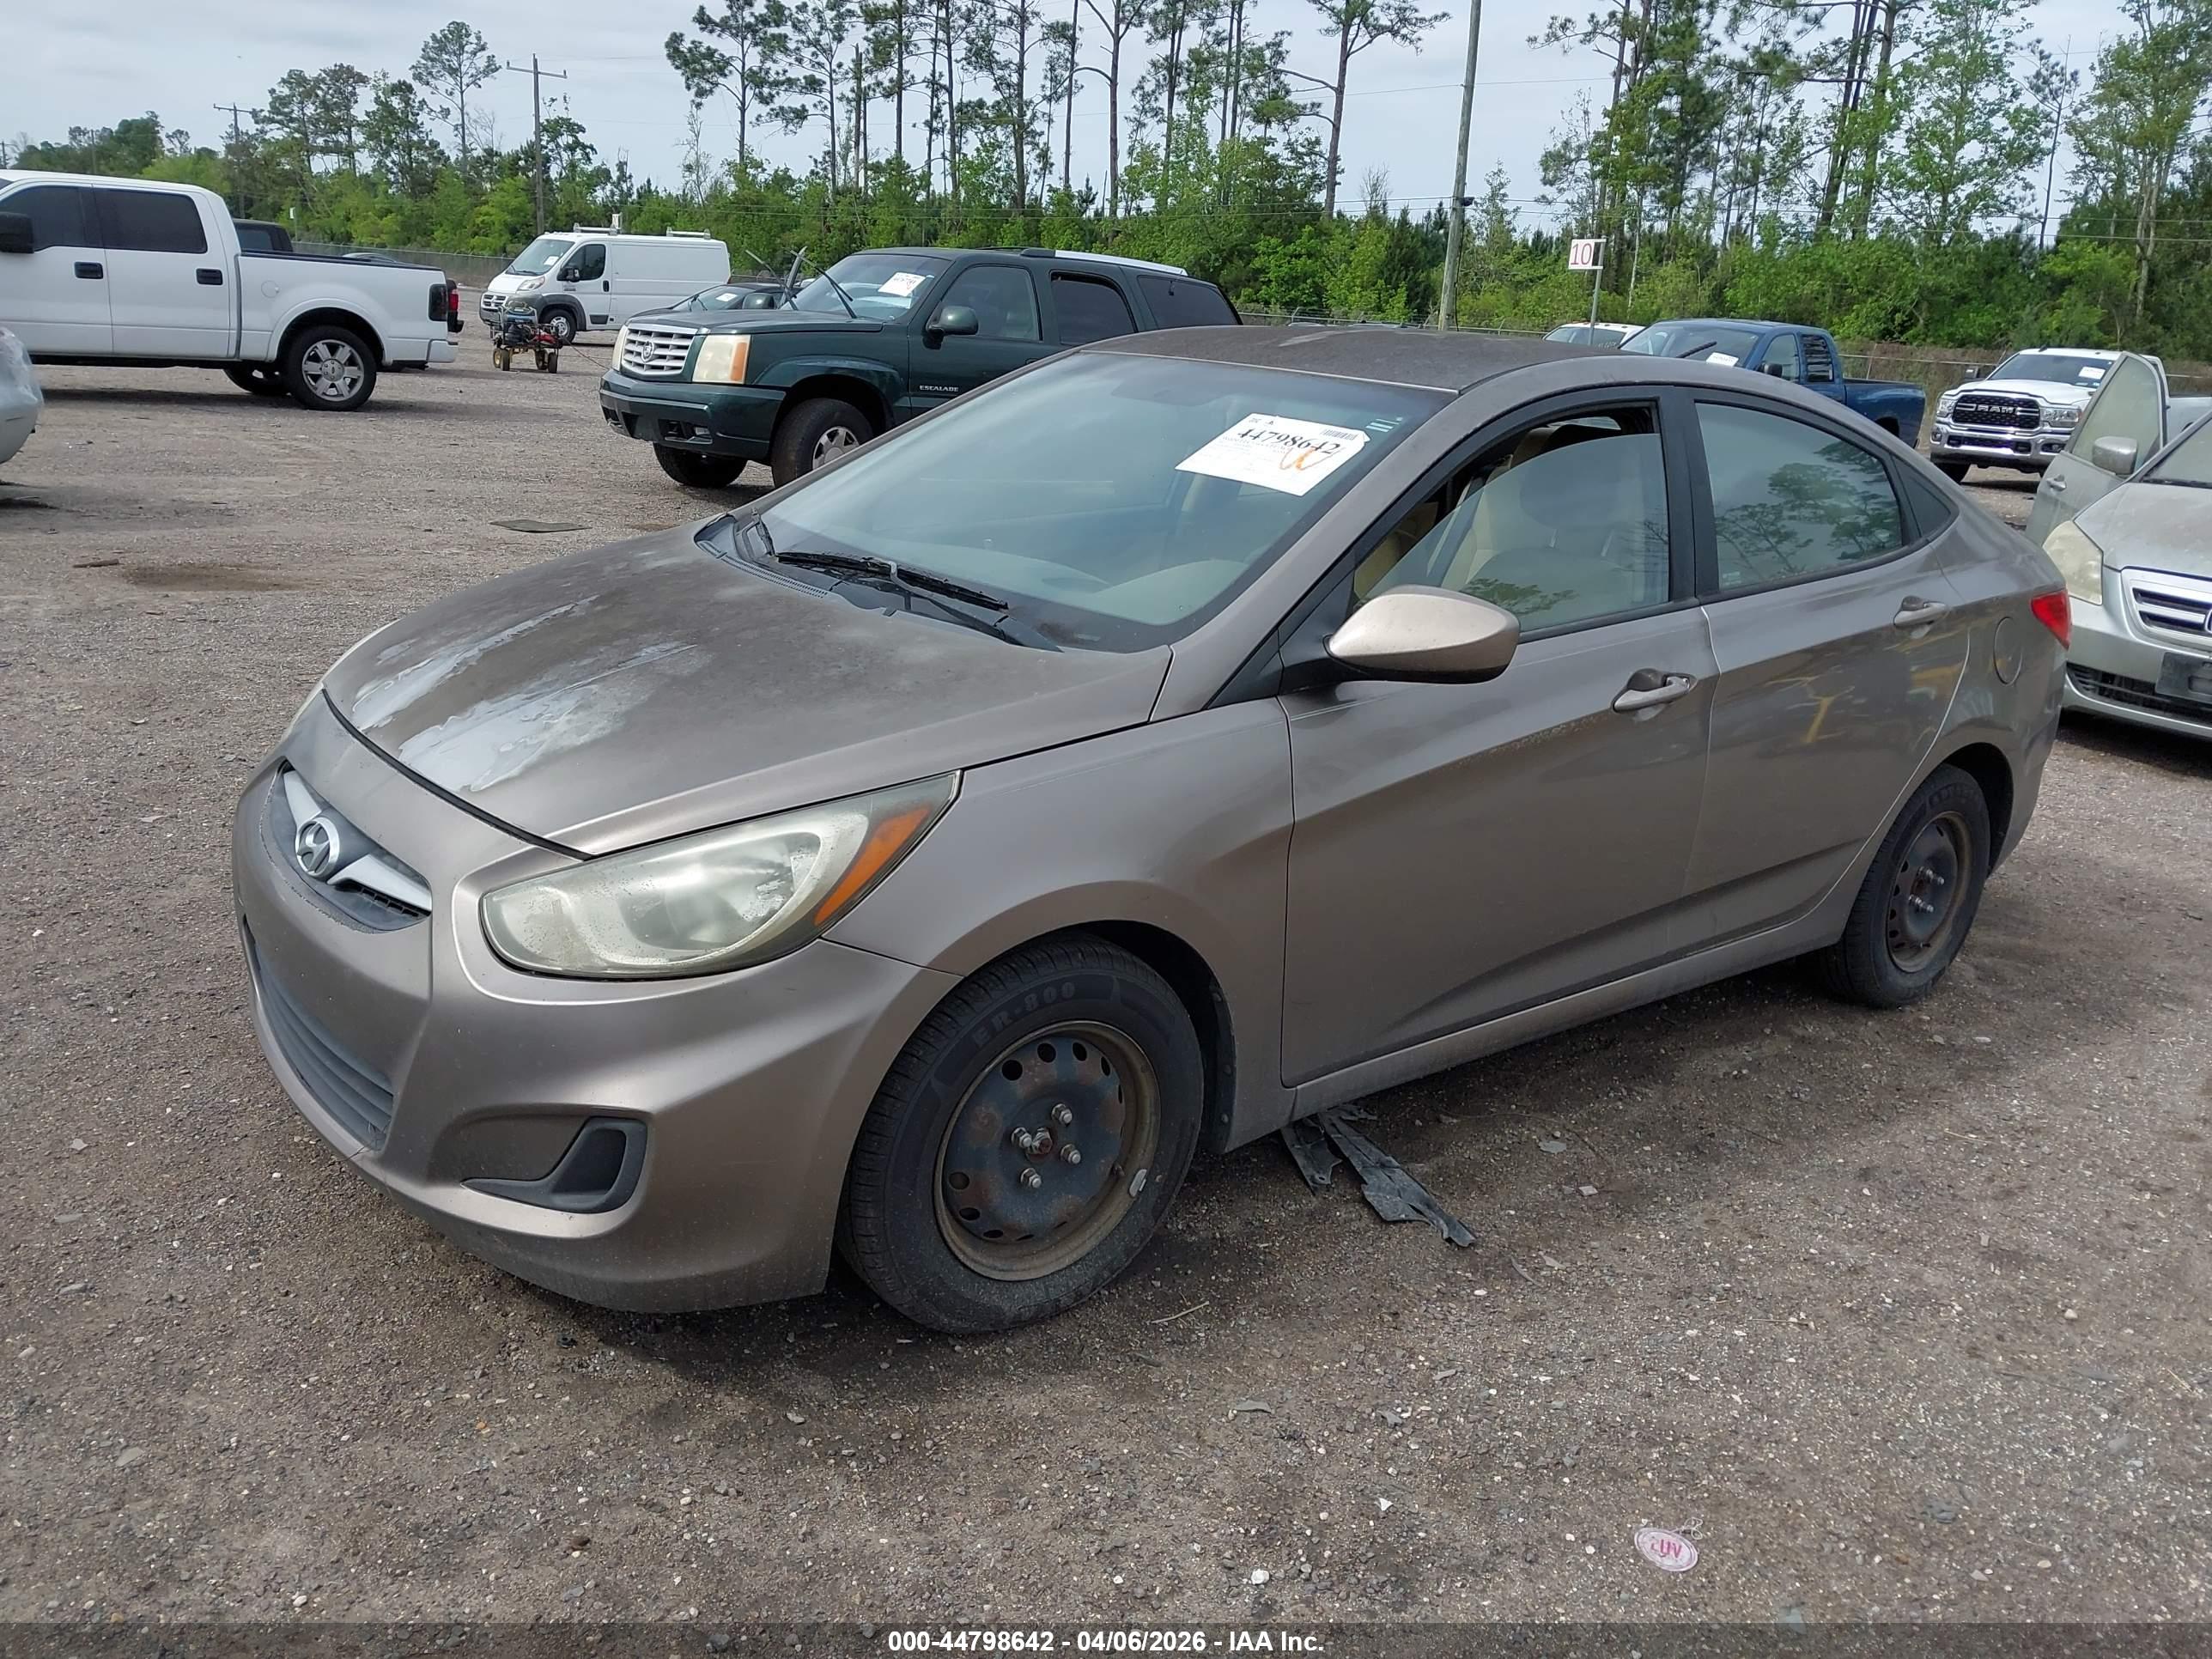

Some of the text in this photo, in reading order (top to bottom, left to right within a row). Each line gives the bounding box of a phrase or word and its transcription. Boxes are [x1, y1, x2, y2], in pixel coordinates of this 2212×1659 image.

[1570, 242, 1593, 265] 10
[1977, 404, 2014, 414] RAM
[1236, 427, 1341, 455] 44798642
